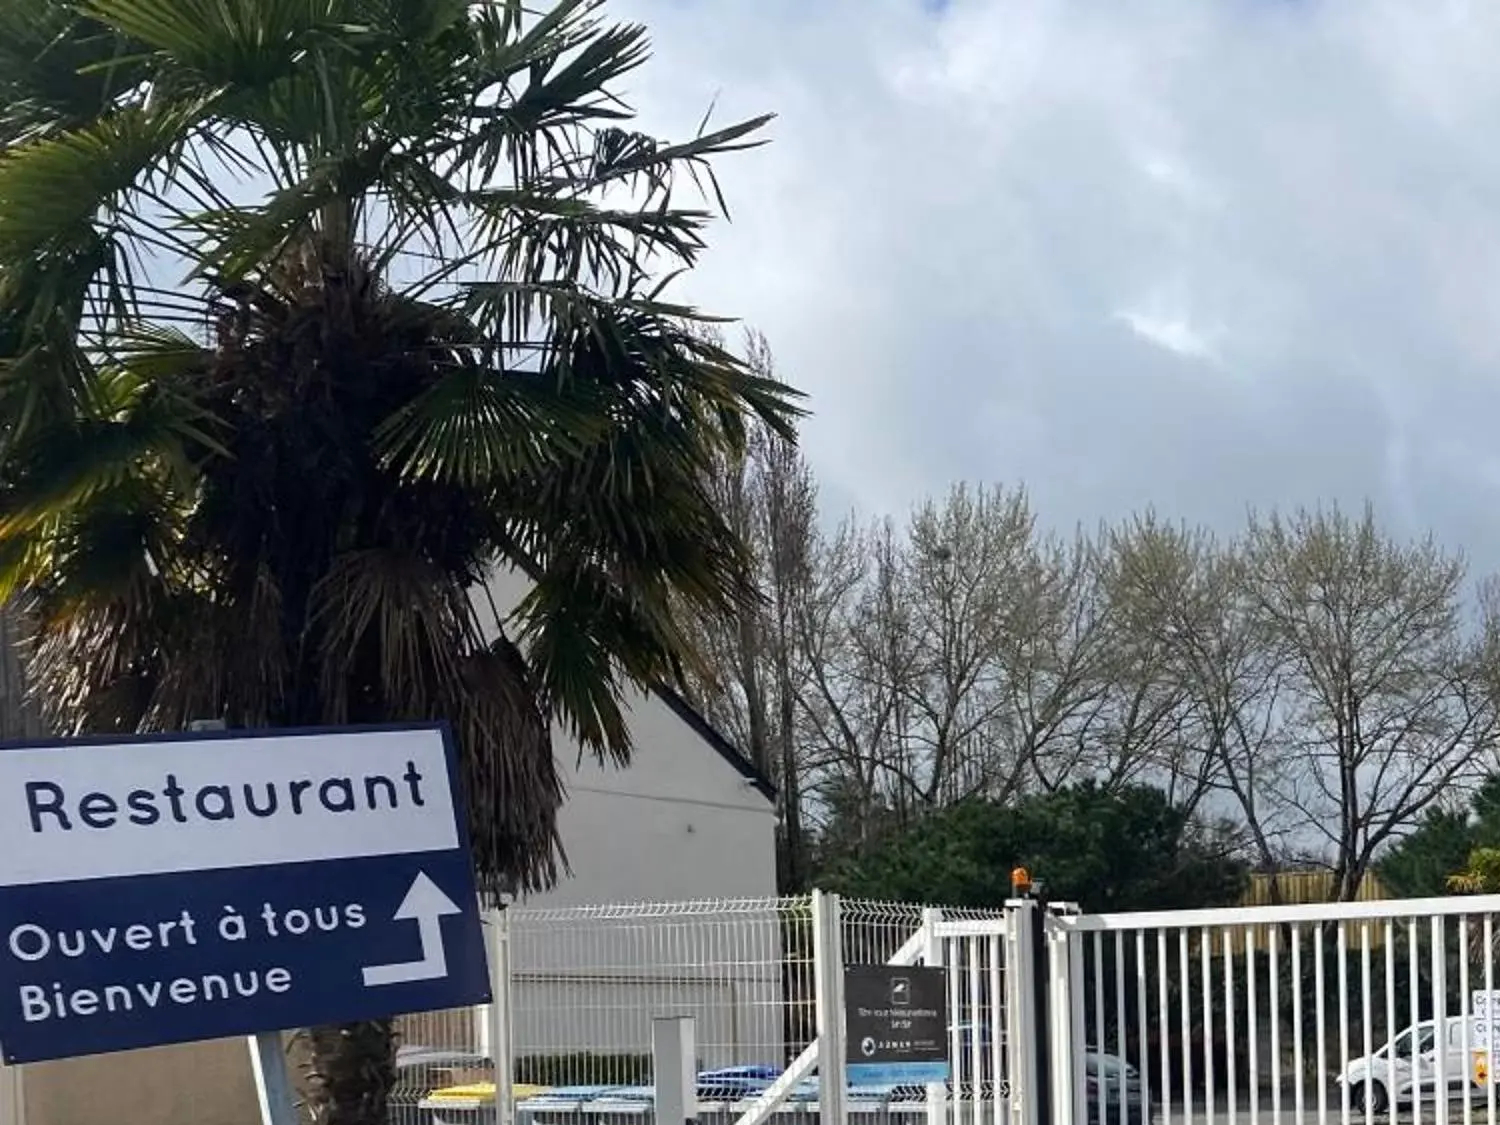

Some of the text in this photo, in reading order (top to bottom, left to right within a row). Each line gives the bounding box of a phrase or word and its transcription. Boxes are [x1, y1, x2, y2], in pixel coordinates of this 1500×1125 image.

[25, 761, 425, 833] Restaurant
[9, 901, 367, 961] Ouvert à tous
[19, 966, 292, 1022] Bienvenue
